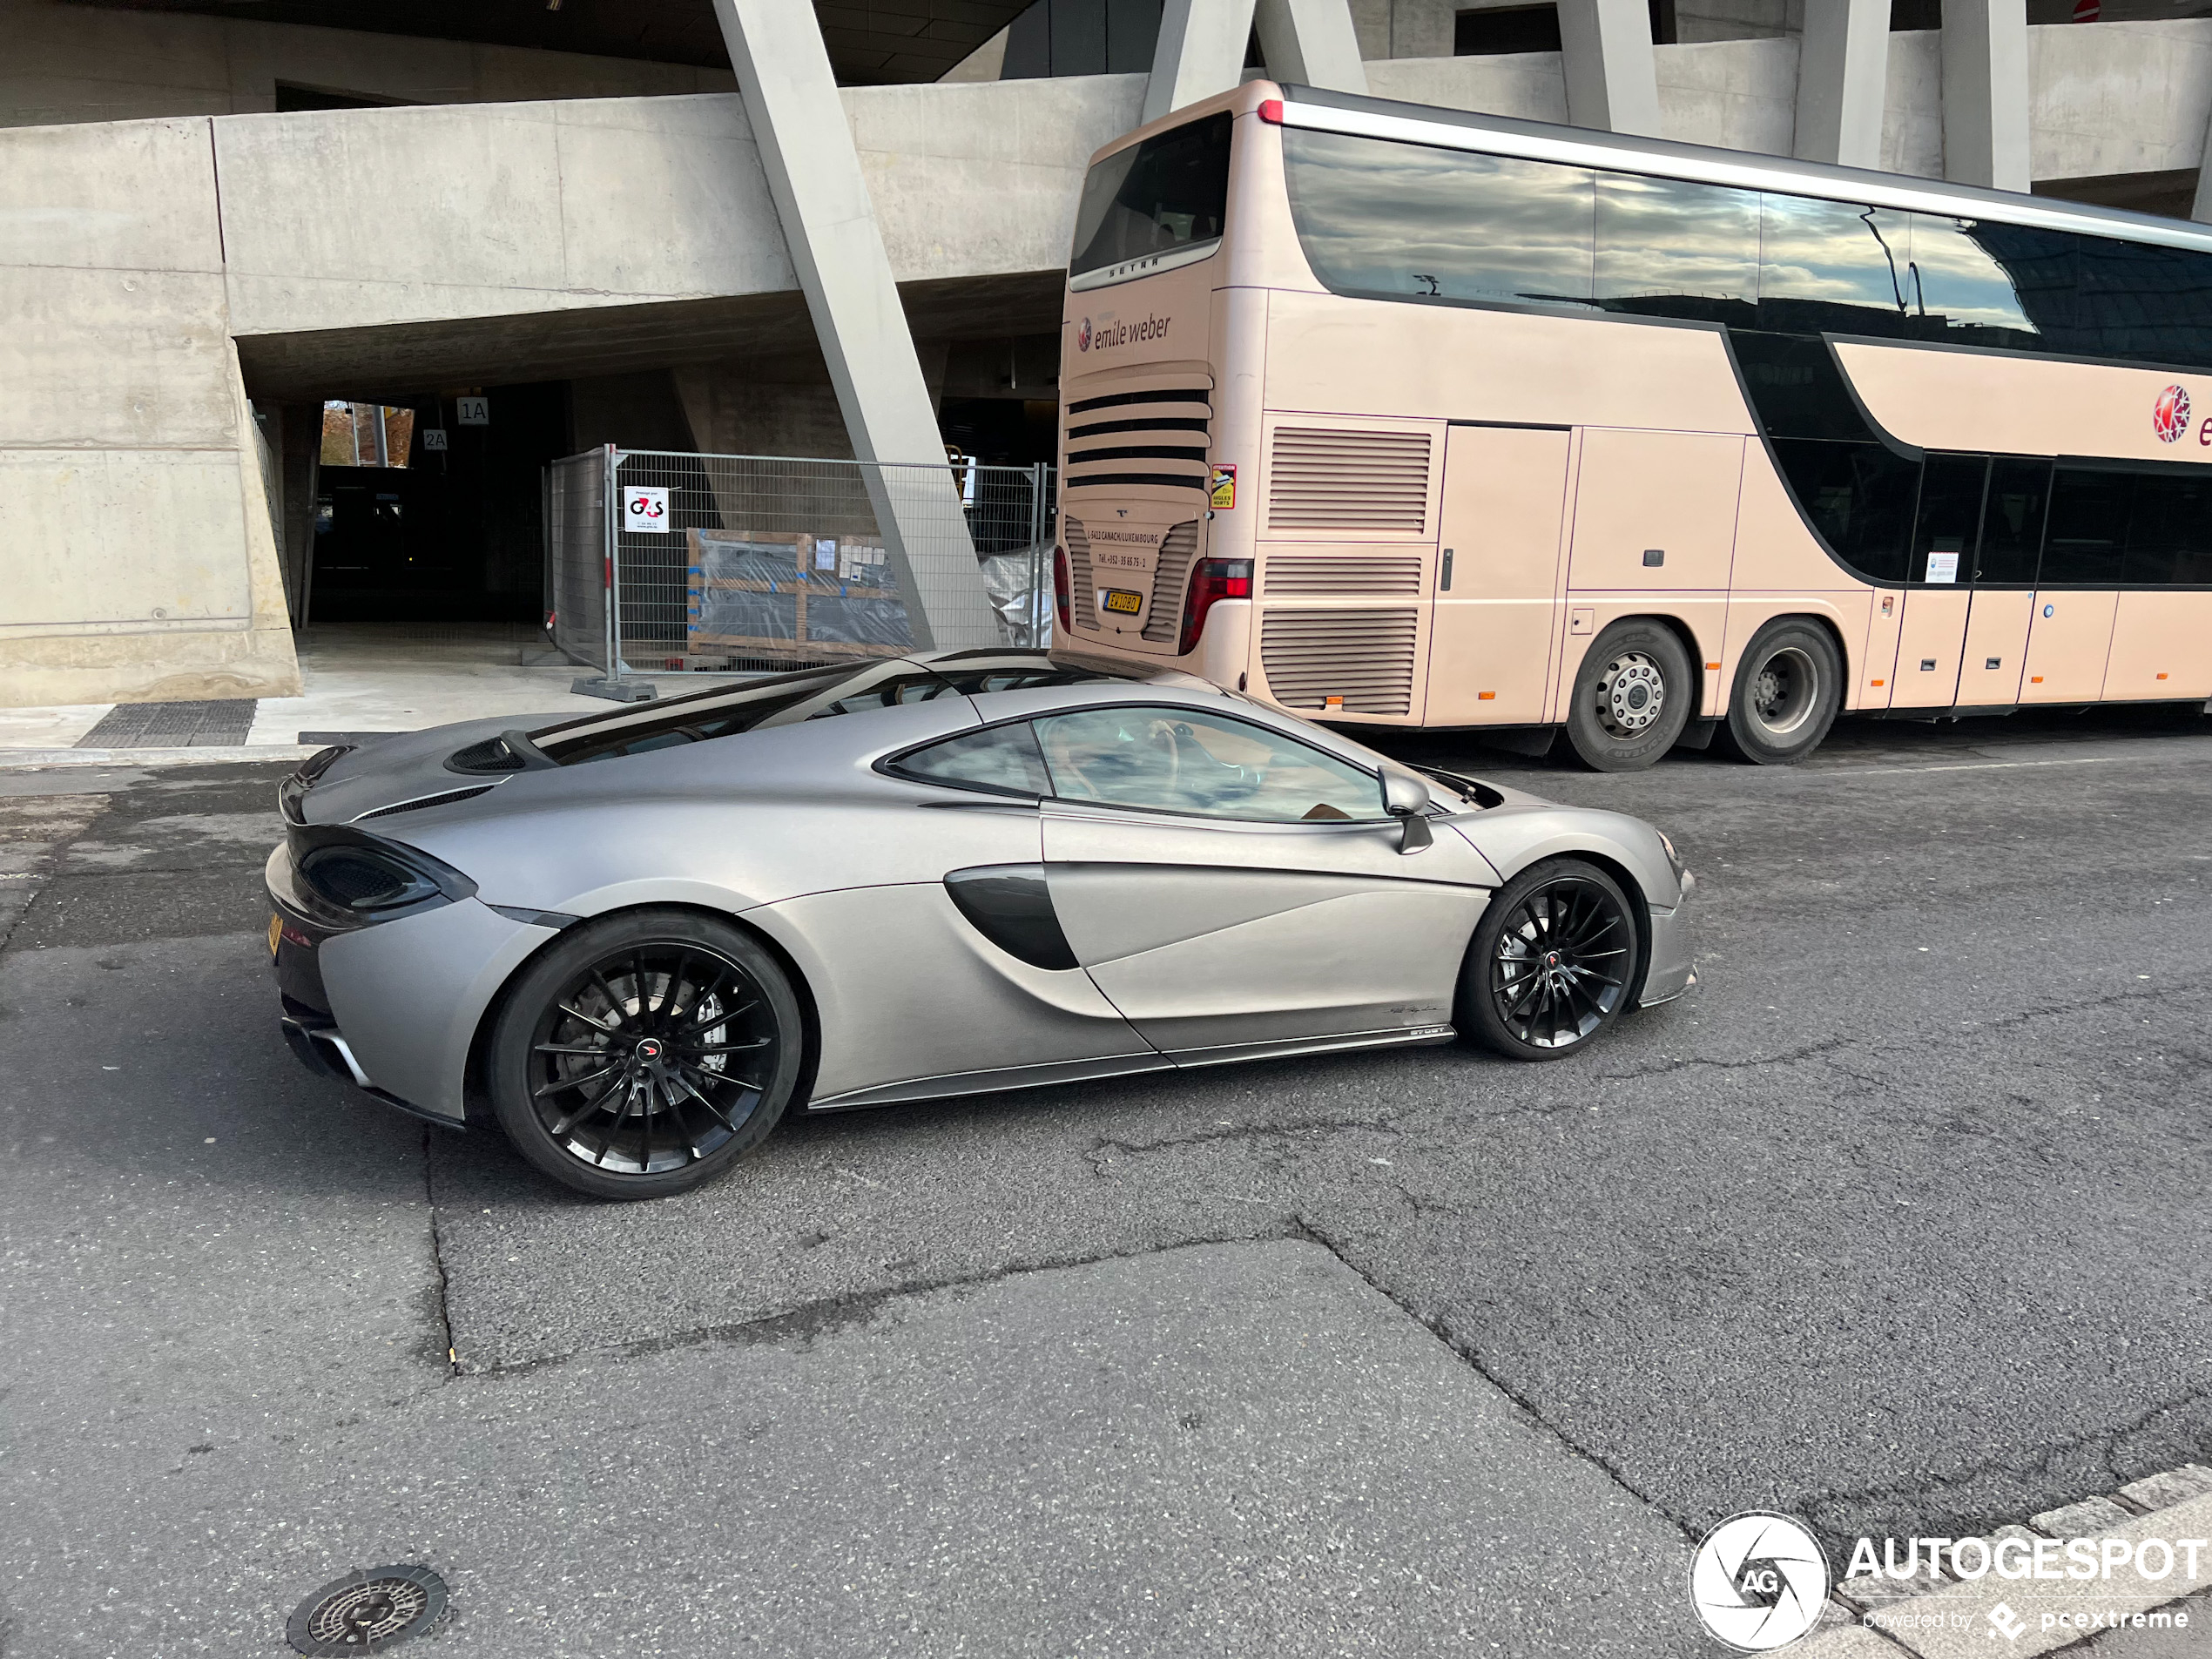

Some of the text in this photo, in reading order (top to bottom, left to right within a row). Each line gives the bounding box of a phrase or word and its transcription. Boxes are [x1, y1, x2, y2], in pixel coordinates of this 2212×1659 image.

[1109, 258, 1158, 278] SETRA
[1095, 313, 1171, 350] emile weber
[462, 402, 486, 420] 1A
[426, 434, 445, 447] 2A
[630, 497, 664, 518] G4S
